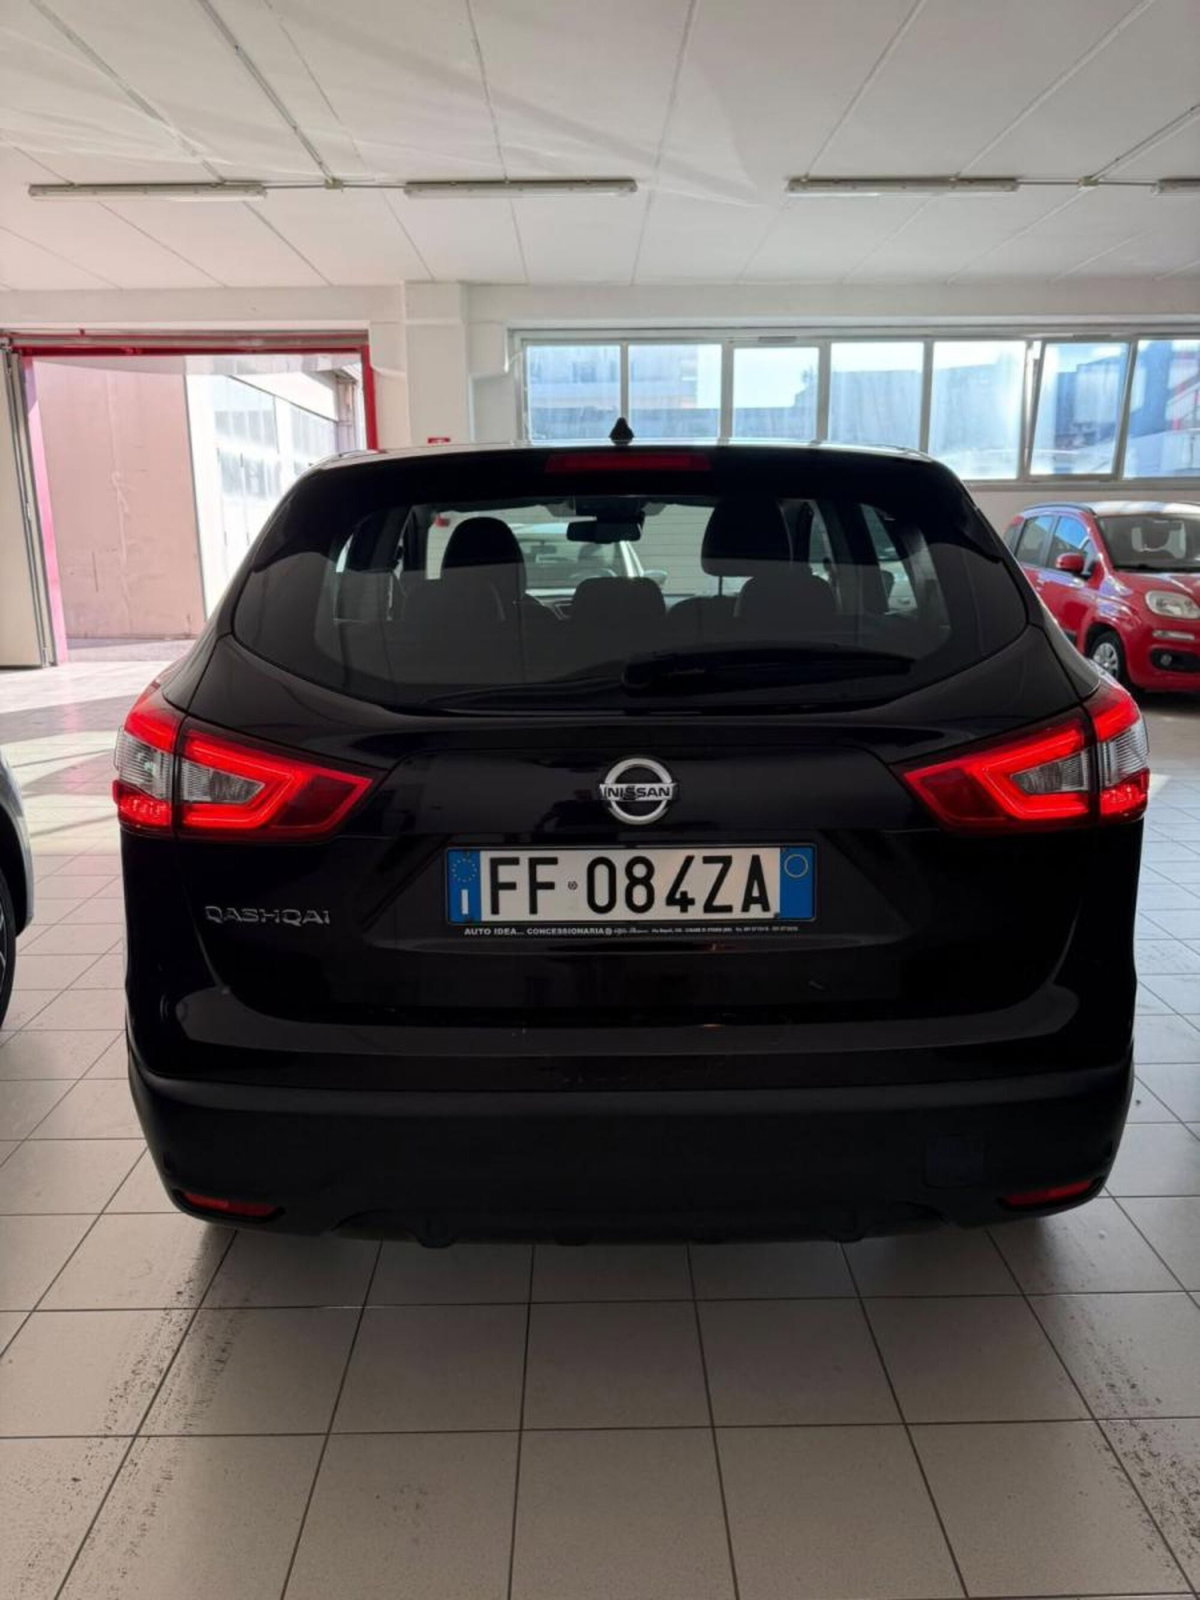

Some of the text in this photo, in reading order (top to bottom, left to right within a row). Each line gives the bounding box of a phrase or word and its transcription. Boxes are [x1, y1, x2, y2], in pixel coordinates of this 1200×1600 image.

[606, 786, 670, 798] NISSAN
[204, 905, 331, 927] QASHQAI
[464, 928, 491, 936] AUTO
[526, 927, 605, 936] CONCESSIONARIA
